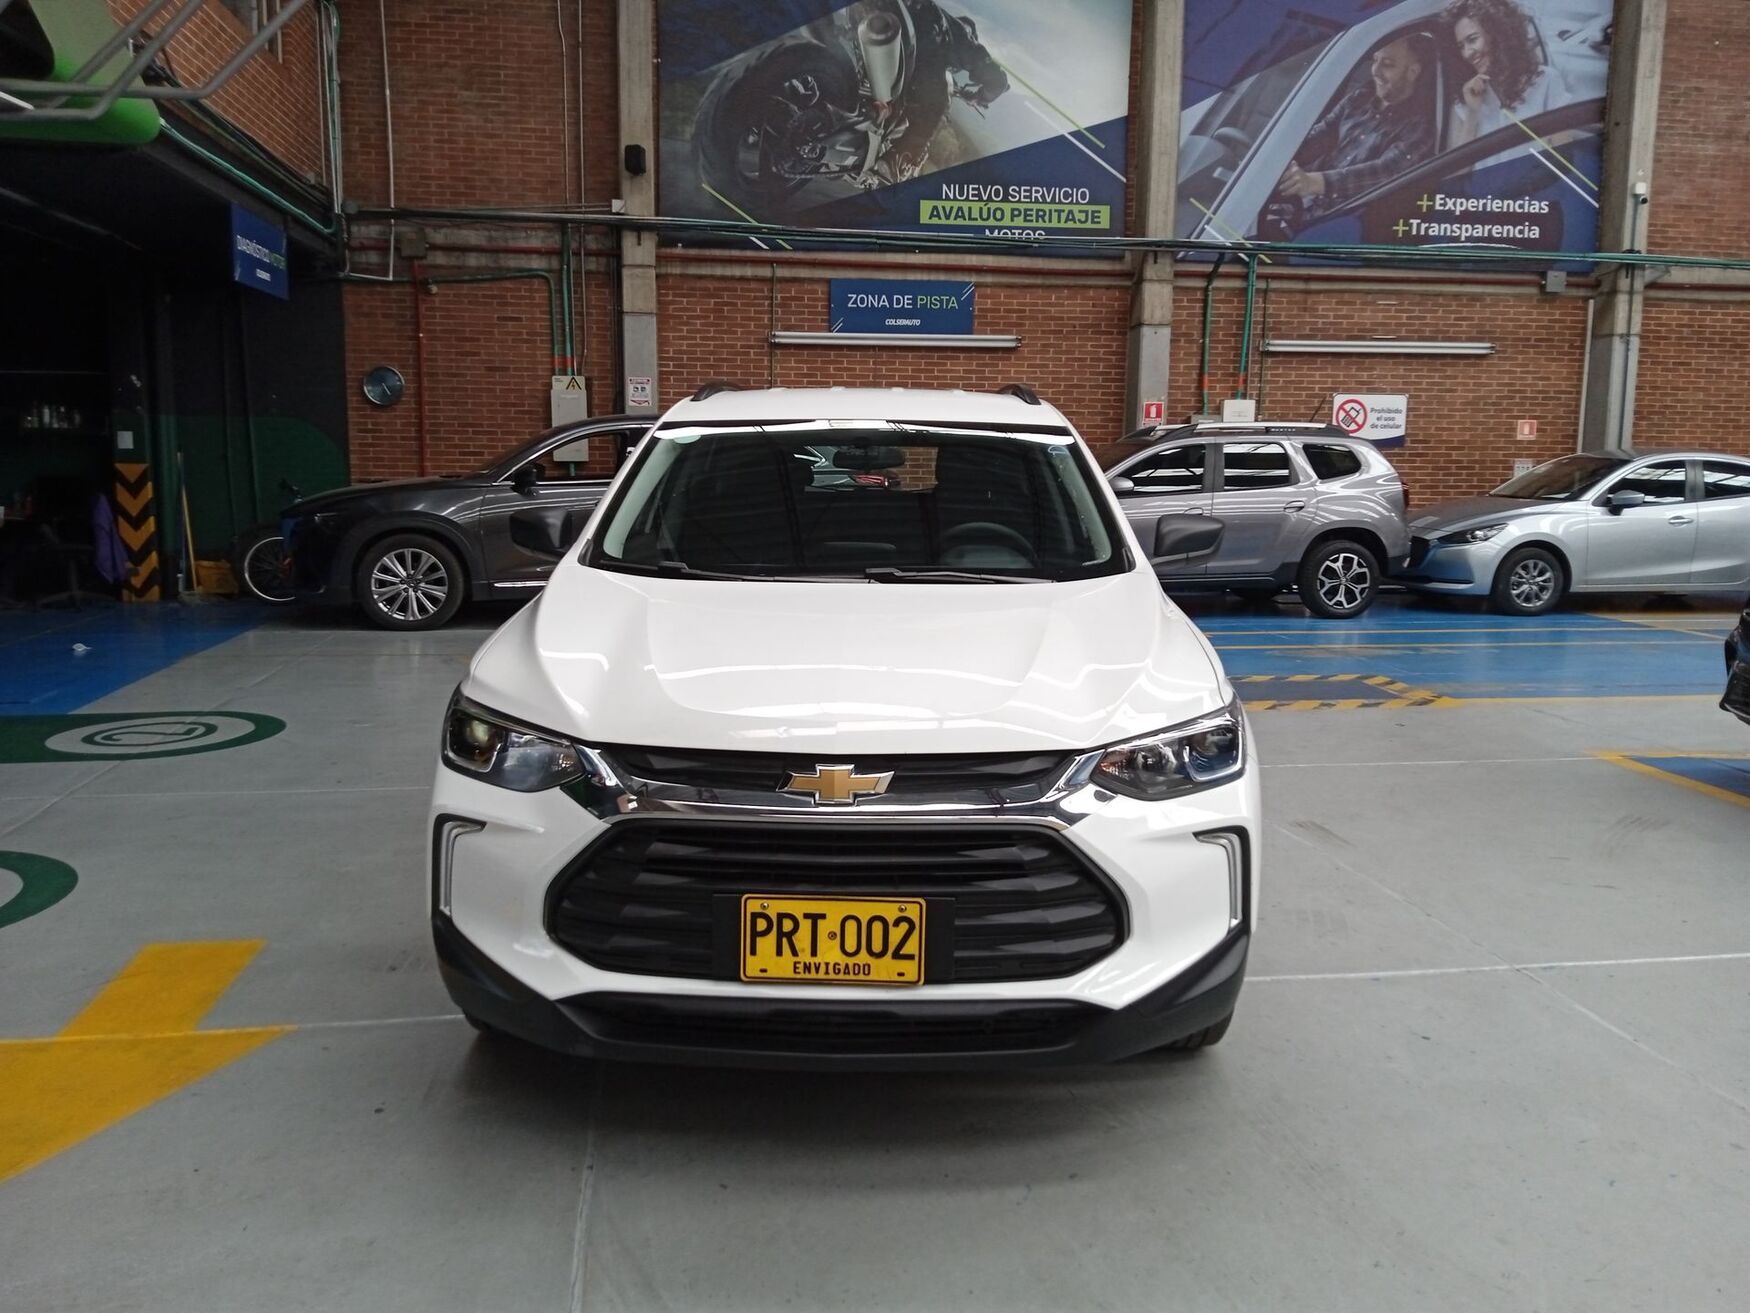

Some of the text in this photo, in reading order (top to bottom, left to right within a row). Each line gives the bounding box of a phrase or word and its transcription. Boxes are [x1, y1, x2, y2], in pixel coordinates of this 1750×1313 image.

[942, 184, 1090, 203] NUEVO SERVICIO
[928, 202, 1102, 225] AVALÚO PERITAJE
[847, 294, 959, 310] ZONA DE PISTA
[793, 961, 872, 976] ENVIGADO
